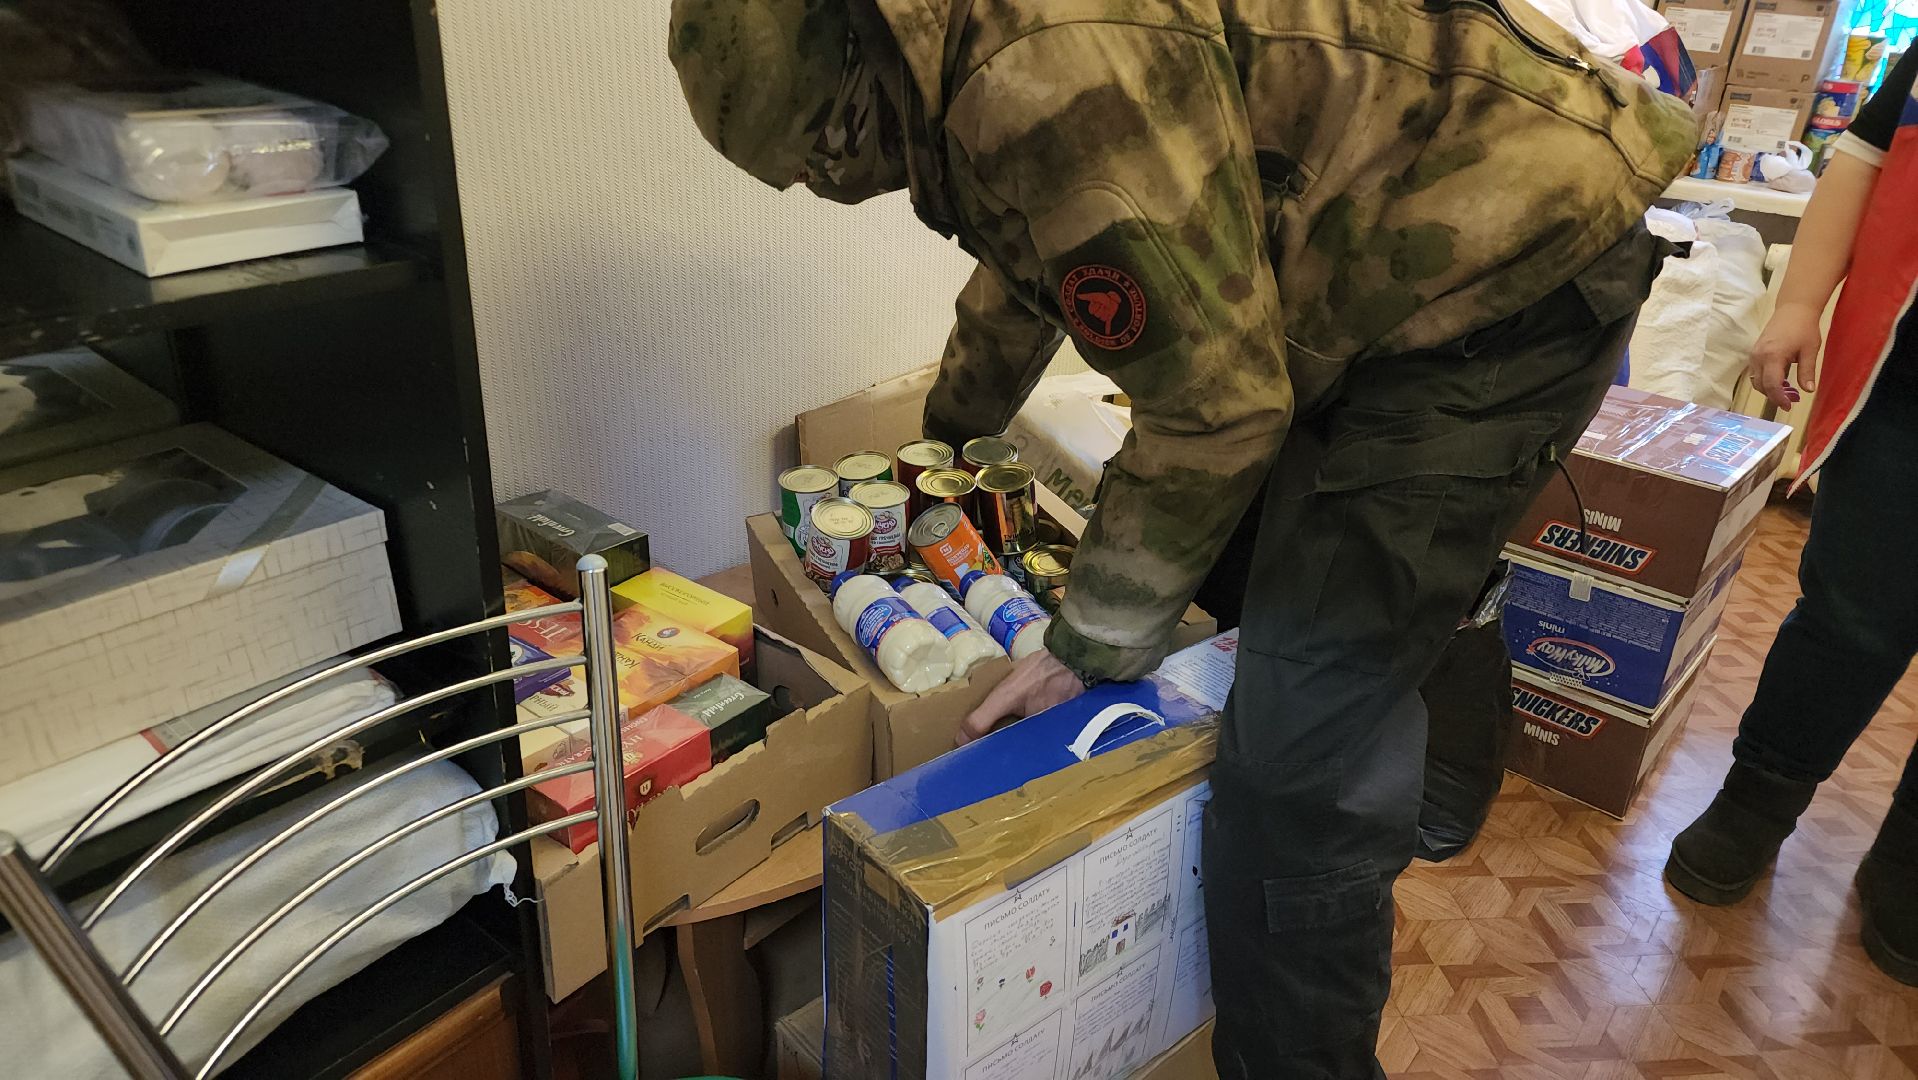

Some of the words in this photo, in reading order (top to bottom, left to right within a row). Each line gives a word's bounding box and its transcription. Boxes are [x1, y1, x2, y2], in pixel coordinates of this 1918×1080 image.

[528, 513, 576, 537] Greenfield
[1583, 508, 1622, 532] MINIS
[1540, 524, 1649, 570] SNICKERS
[1538, 620, 1566, 634] minis
[529, 694, 559, 712] РНЫЙ
[702, 691, 745, 718] Greenfield
[1512, 687, 1601, 735] SNICKERS
[1523, 722, 1560, 746] MINIS
[1100, 844, 1128, 864] ПИСЬМО
[1129, 827, 1158, 847] СОЛДАТУ
[984, 906, 1017, 930] ПИСЬМО
[1018, 888, 1050, 910] СОЛДАТУ
[982, 1050, 1013, 1073] ПИСЬМО
[1014, 1028, 1046, 1051] СОЛДАТУ
